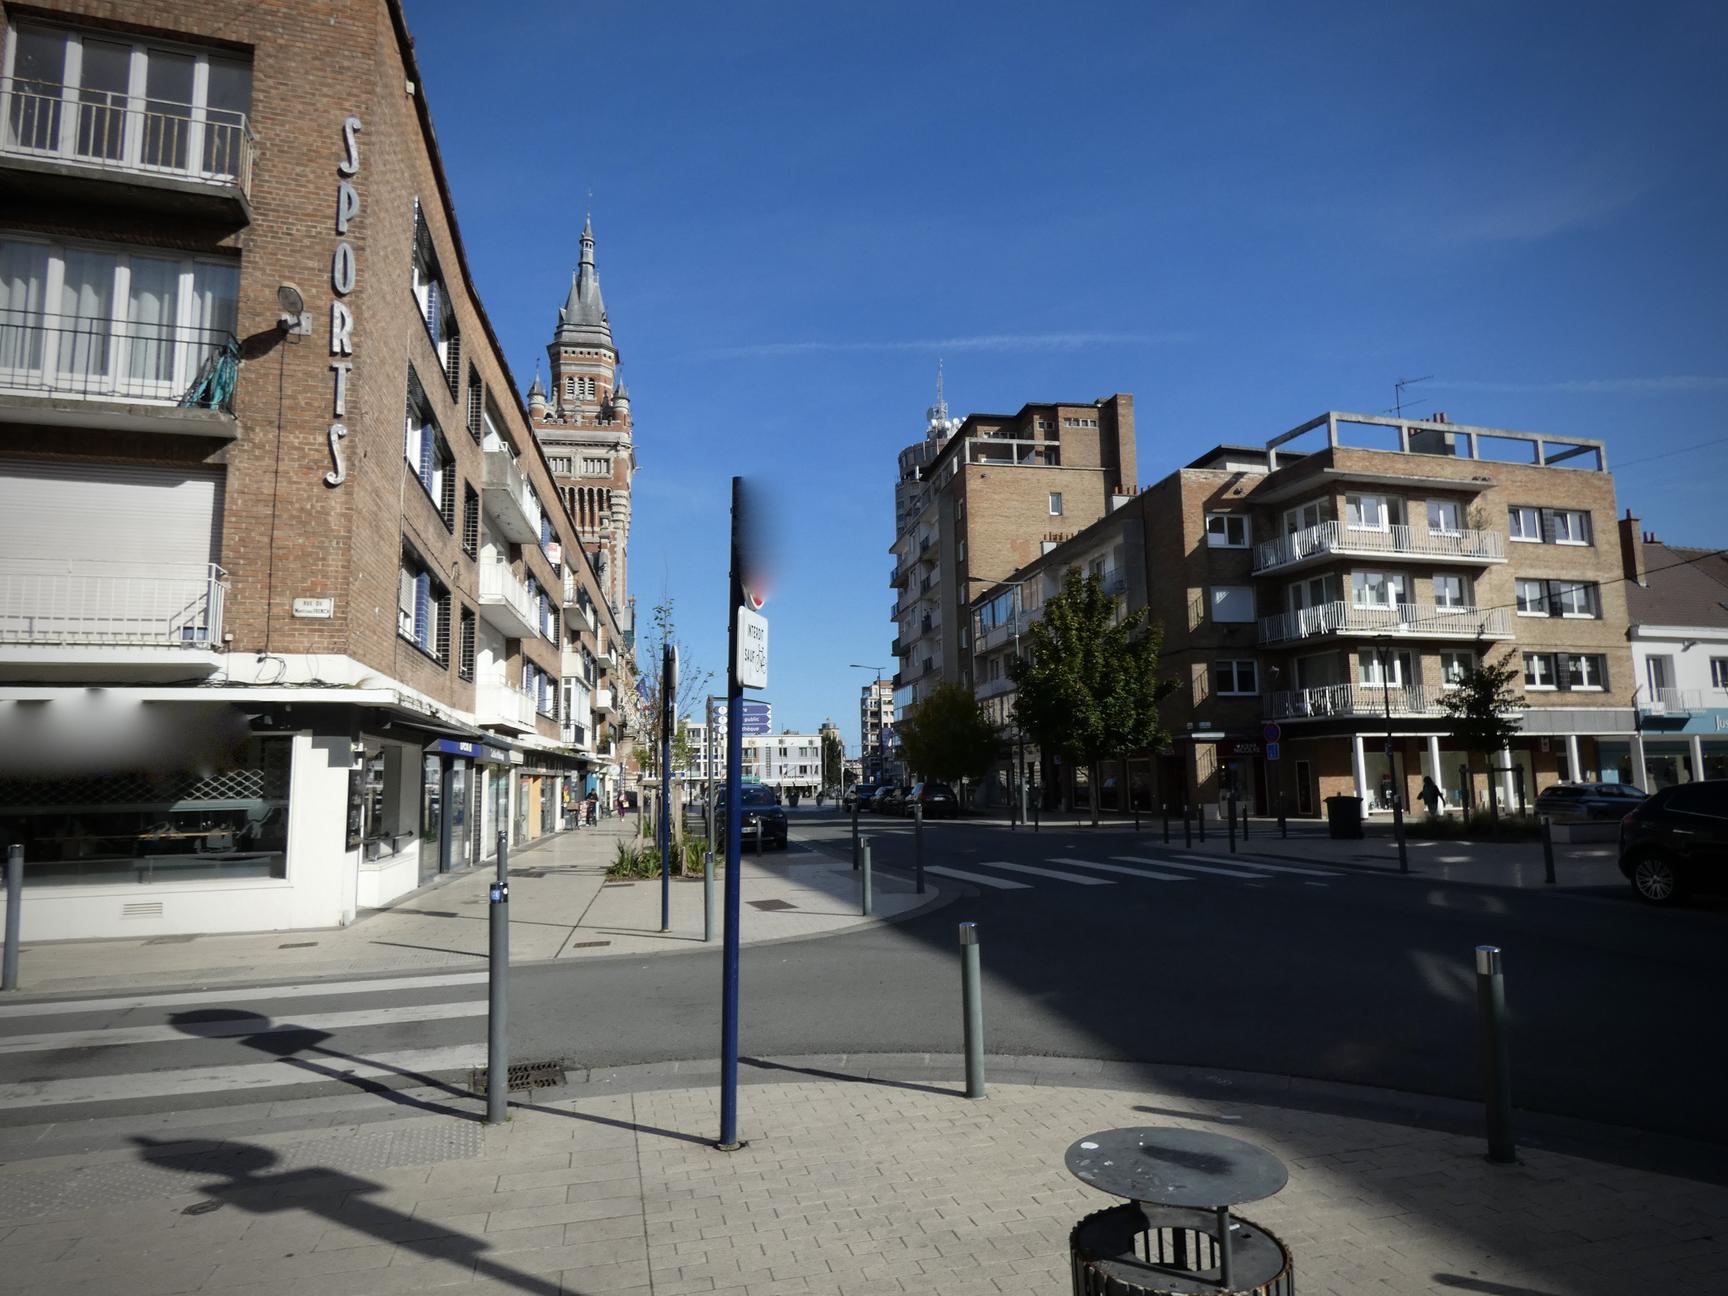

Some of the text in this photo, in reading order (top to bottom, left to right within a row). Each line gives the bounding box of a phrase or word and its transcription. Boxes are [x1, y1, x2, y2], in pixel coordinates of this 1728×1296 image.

[325, 116, 362, 485] SPORTS
[747, 624, 764, 642] INTERDIT
[744, 648, 755, 663] SAUF
